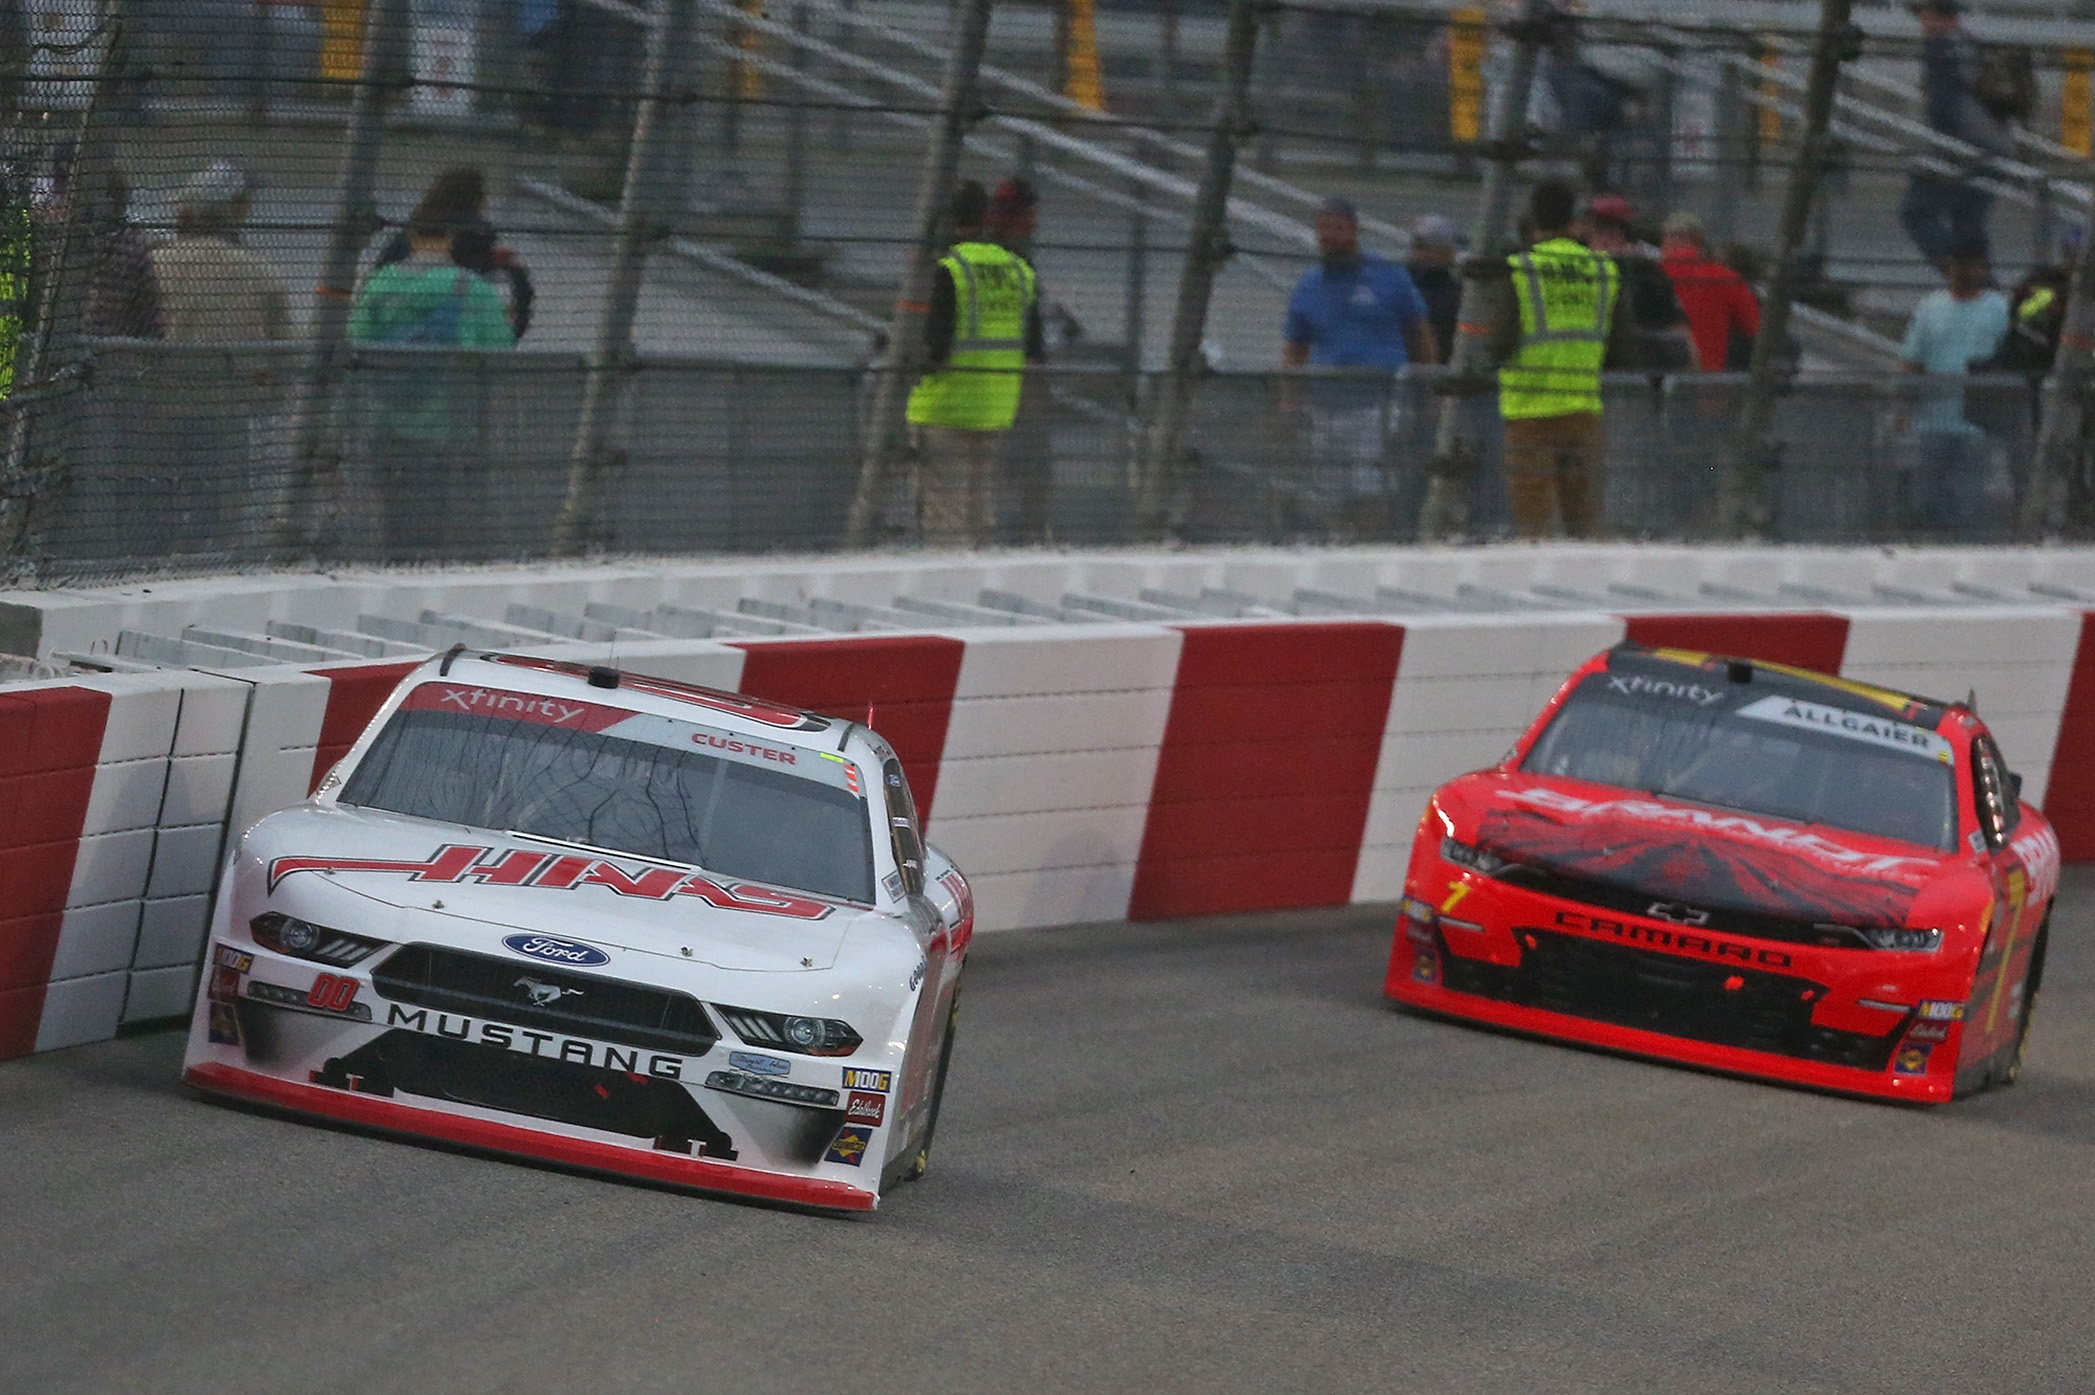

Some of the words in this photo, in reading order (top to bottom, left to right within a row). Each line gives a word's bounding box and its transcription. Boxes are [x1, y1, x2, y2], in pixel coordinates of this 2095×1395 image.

[440, 687, 584, 723] xfinity
[1607, 674, 1724, 706] xfinity
[1784, 705, 1930, 748] ALLGAIER
[691, 732, 797, 766] CUSTER
[1441, 880, 1470, 913] 7
[523, 937, 589, 962] Ford
[1555, 911, 1791, 967] CAMARO
[306, 972, 361, 1012] 00
[387, 1004, 684, 1080] MUSTANG
[844, 1069, 890, 1091] MOOG
